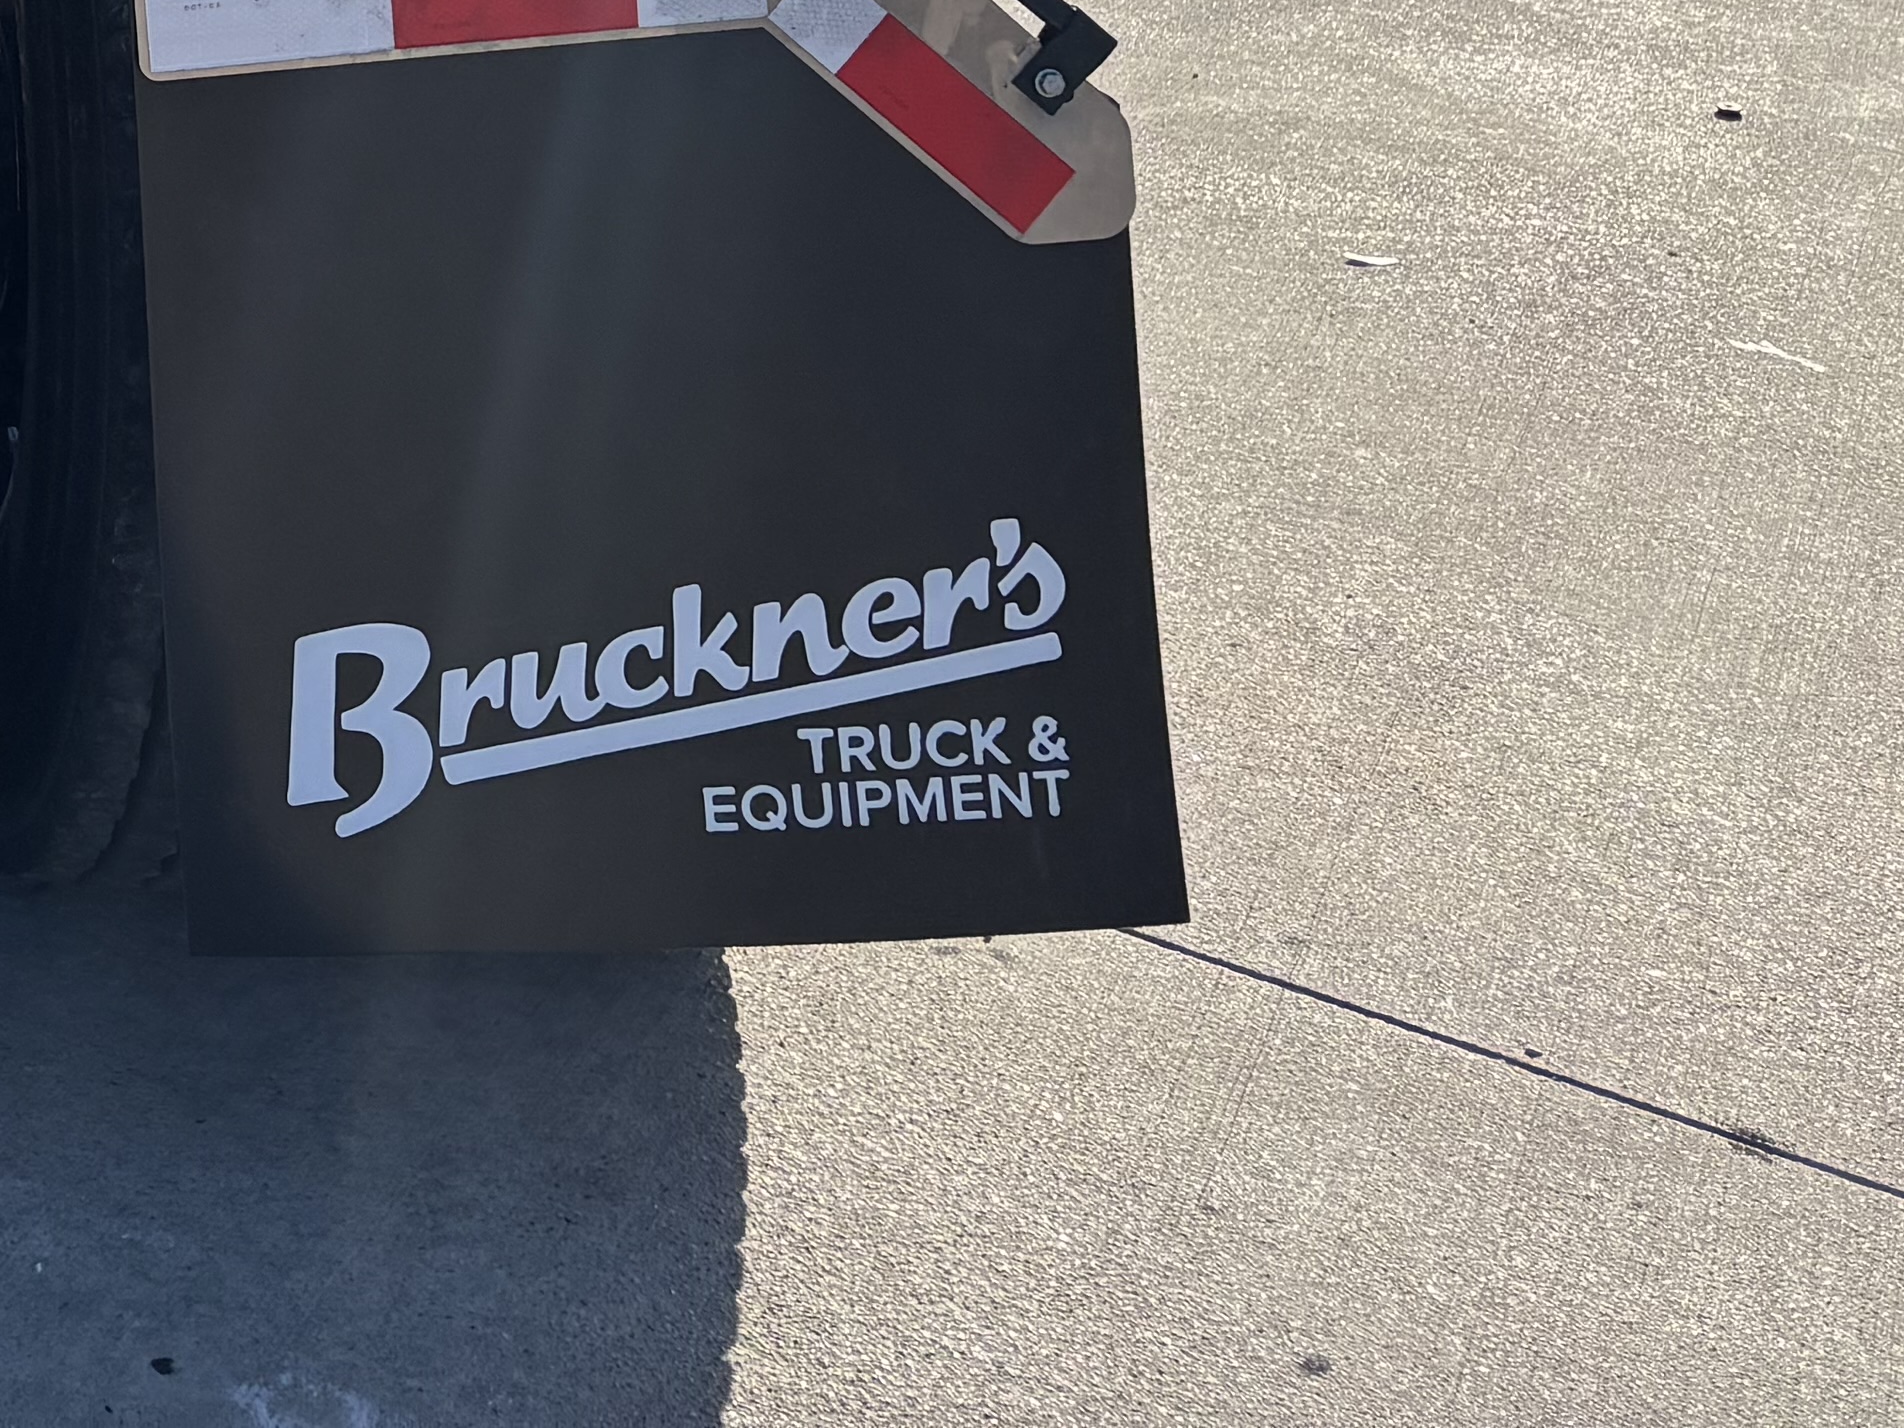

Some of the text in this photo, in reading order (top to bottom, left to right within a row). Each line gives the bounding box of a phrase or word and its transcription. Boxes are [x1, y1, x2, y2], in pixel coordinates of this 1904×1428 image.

[287, 519, 1066, 837] Bruckner's
[796, 715, 1070, 774] TRUCK &
[702, 770, 1070, 833] EQUIPMENT
